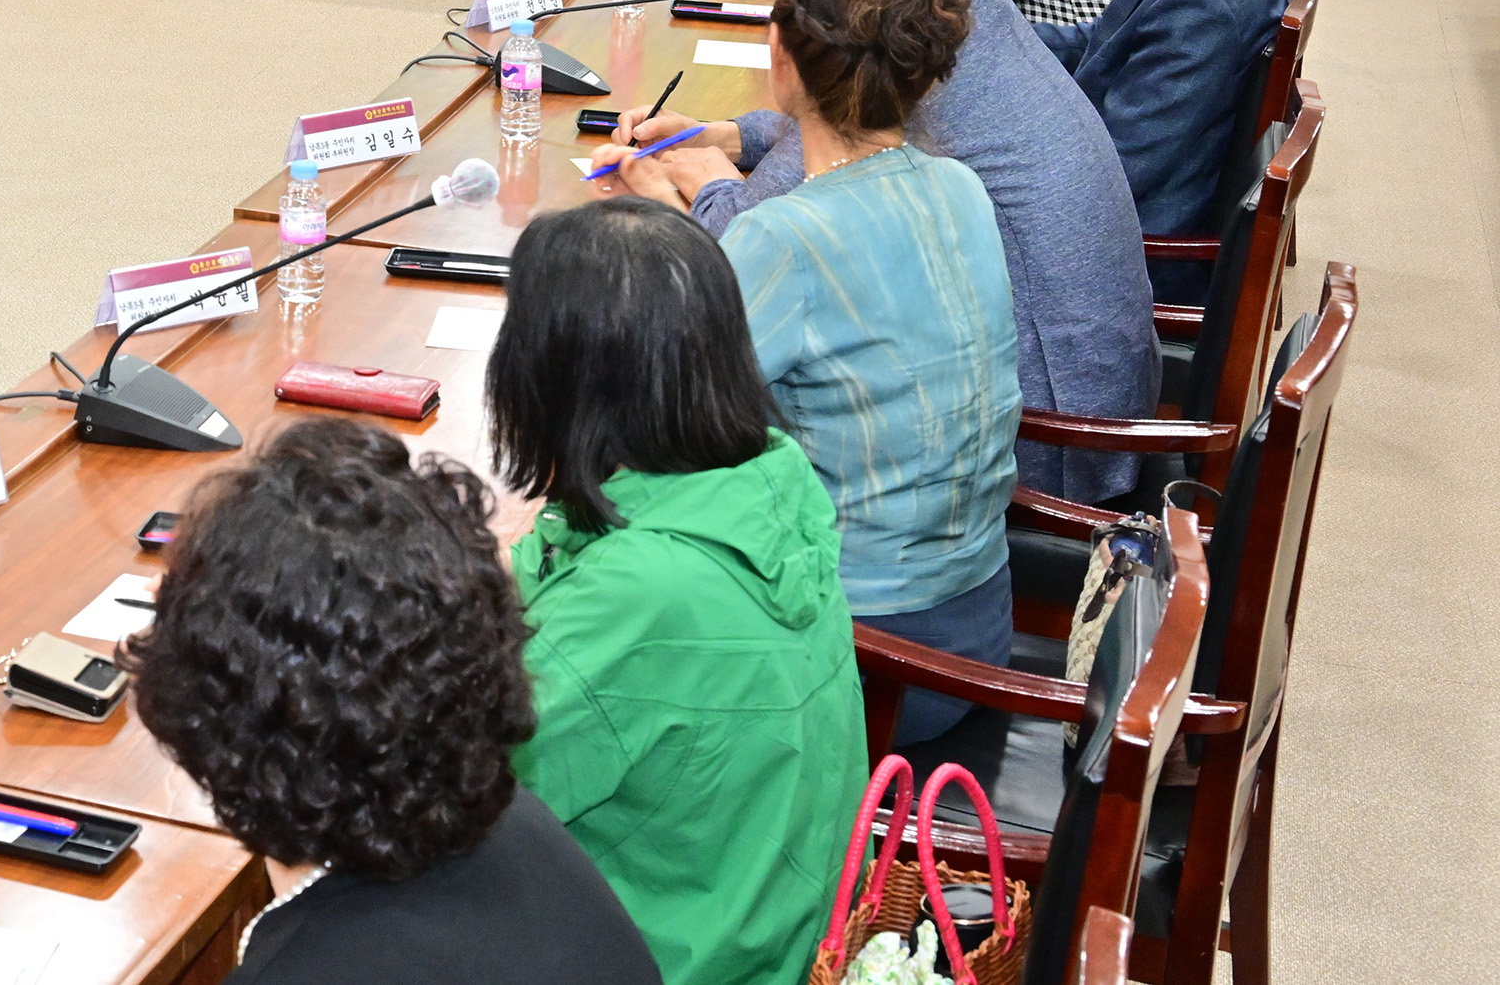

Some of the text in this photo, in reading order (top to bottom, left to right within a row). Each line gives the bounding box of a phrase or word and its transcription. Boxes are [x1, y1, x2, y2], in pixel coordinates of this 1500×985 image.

[332, 136, 356, 147] 주민자치
[365, 127, 415, 152] 김일수
[148, 293, 177, 308] 주민자치
